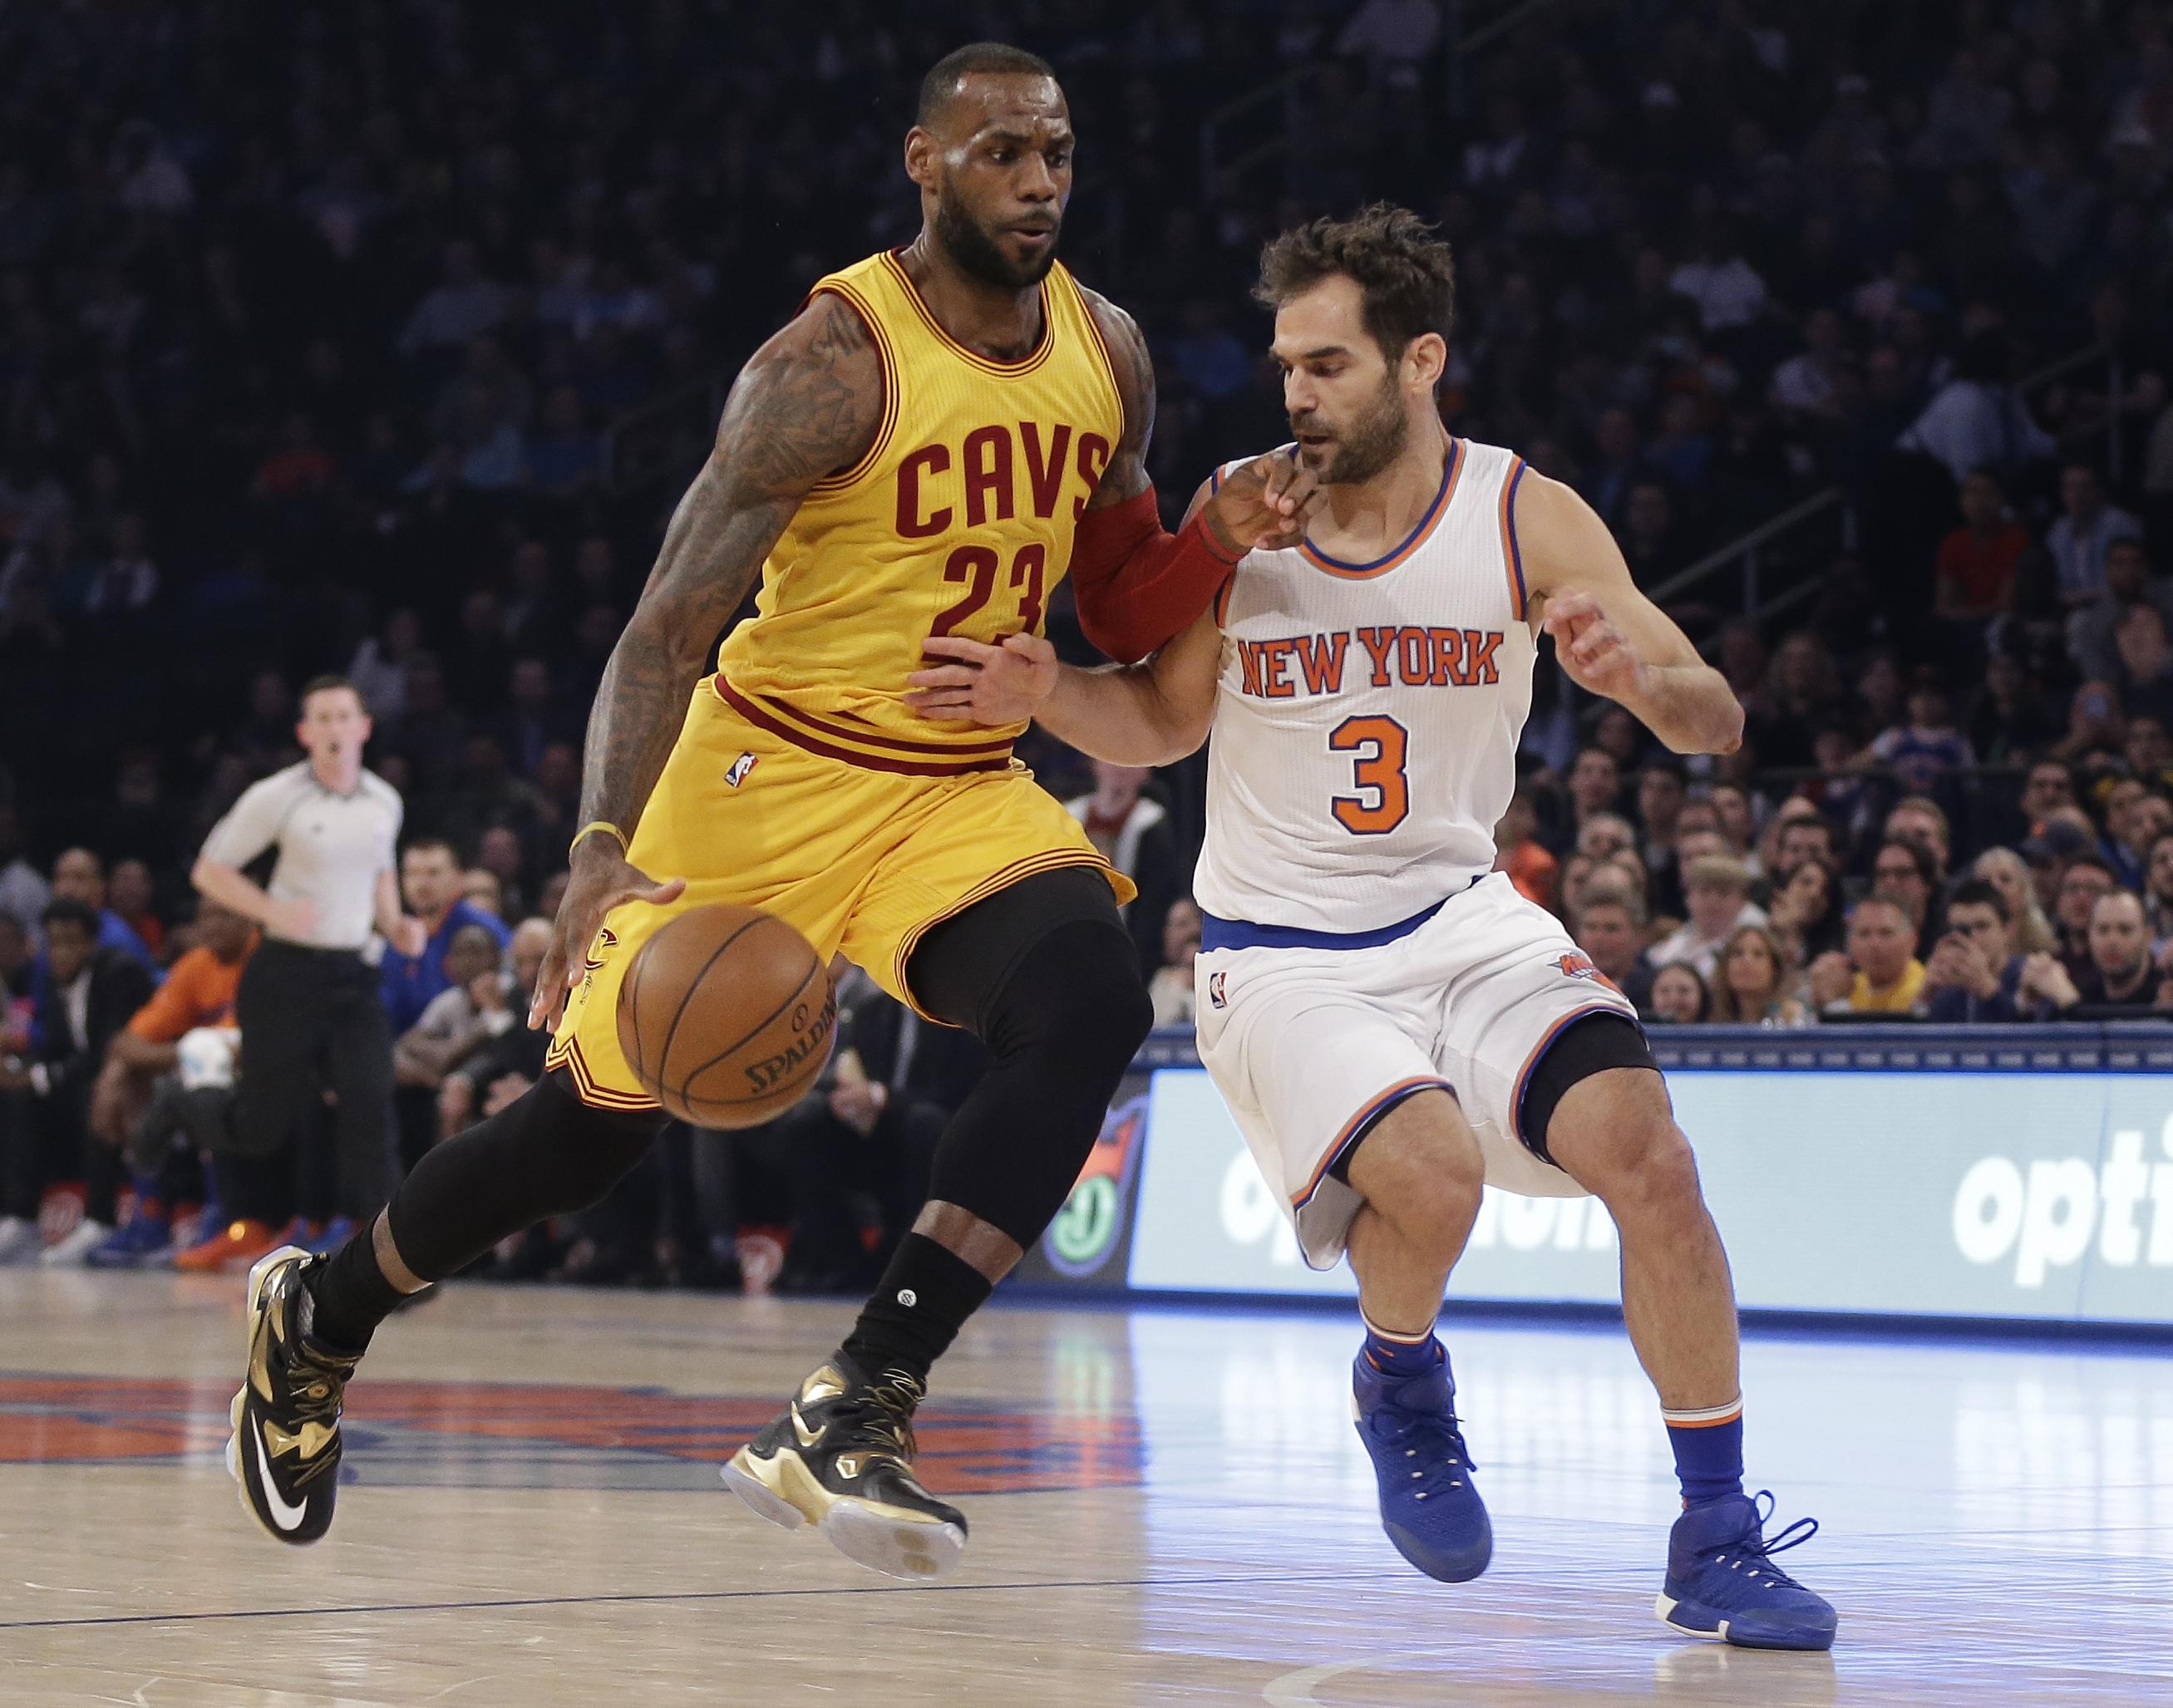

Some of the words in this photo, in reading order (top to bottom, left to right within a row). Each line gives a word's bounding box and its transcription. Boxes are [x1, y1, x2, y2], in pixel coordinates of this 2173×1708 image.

[895, 421, 1111, 539] CAVS
[921, 544, 1046, 667] 23
[1237, 631, 1351, 698] NEW
[1357, 626, 1504, 687] YORK
[1329, 714, 1409, 835] 3
[744, 1000, 837, 1093] SPALDIN
